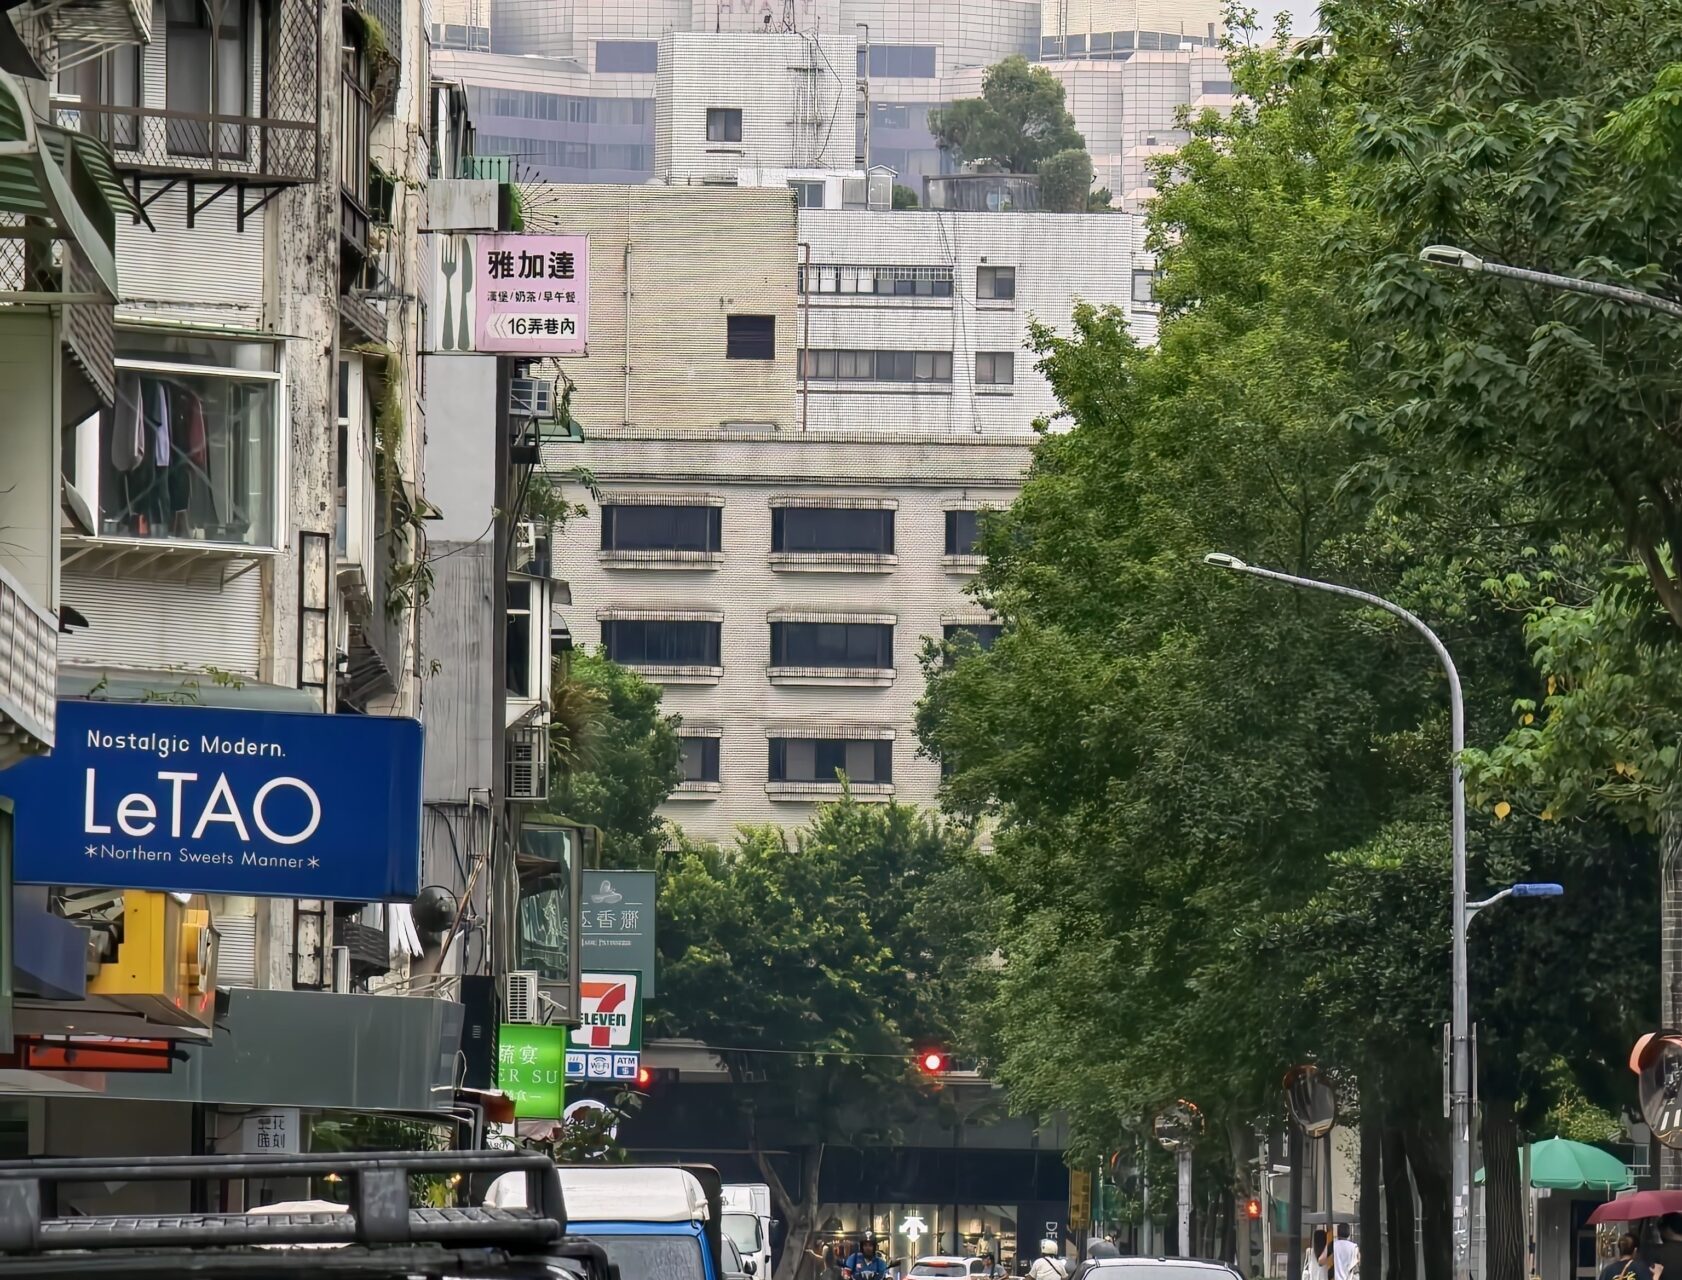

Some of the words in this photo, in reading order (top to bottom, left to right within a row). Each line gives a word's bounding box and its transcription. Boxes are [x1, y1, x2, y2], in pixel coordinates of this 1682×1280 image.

[488, 250, 575, 280] 雅加達
[508, 318, 575, 335] 16弄巷內
[87, 729, 190, 758] Nostalgic
[201, 736, 287, 757] Modern.
[84, 767, 322, 845] LeTAO
[180, 848, 234, 864] Sweets
[616, 1056, 637, 1065] ATM
[531, 1069, 559, 1084] SU
